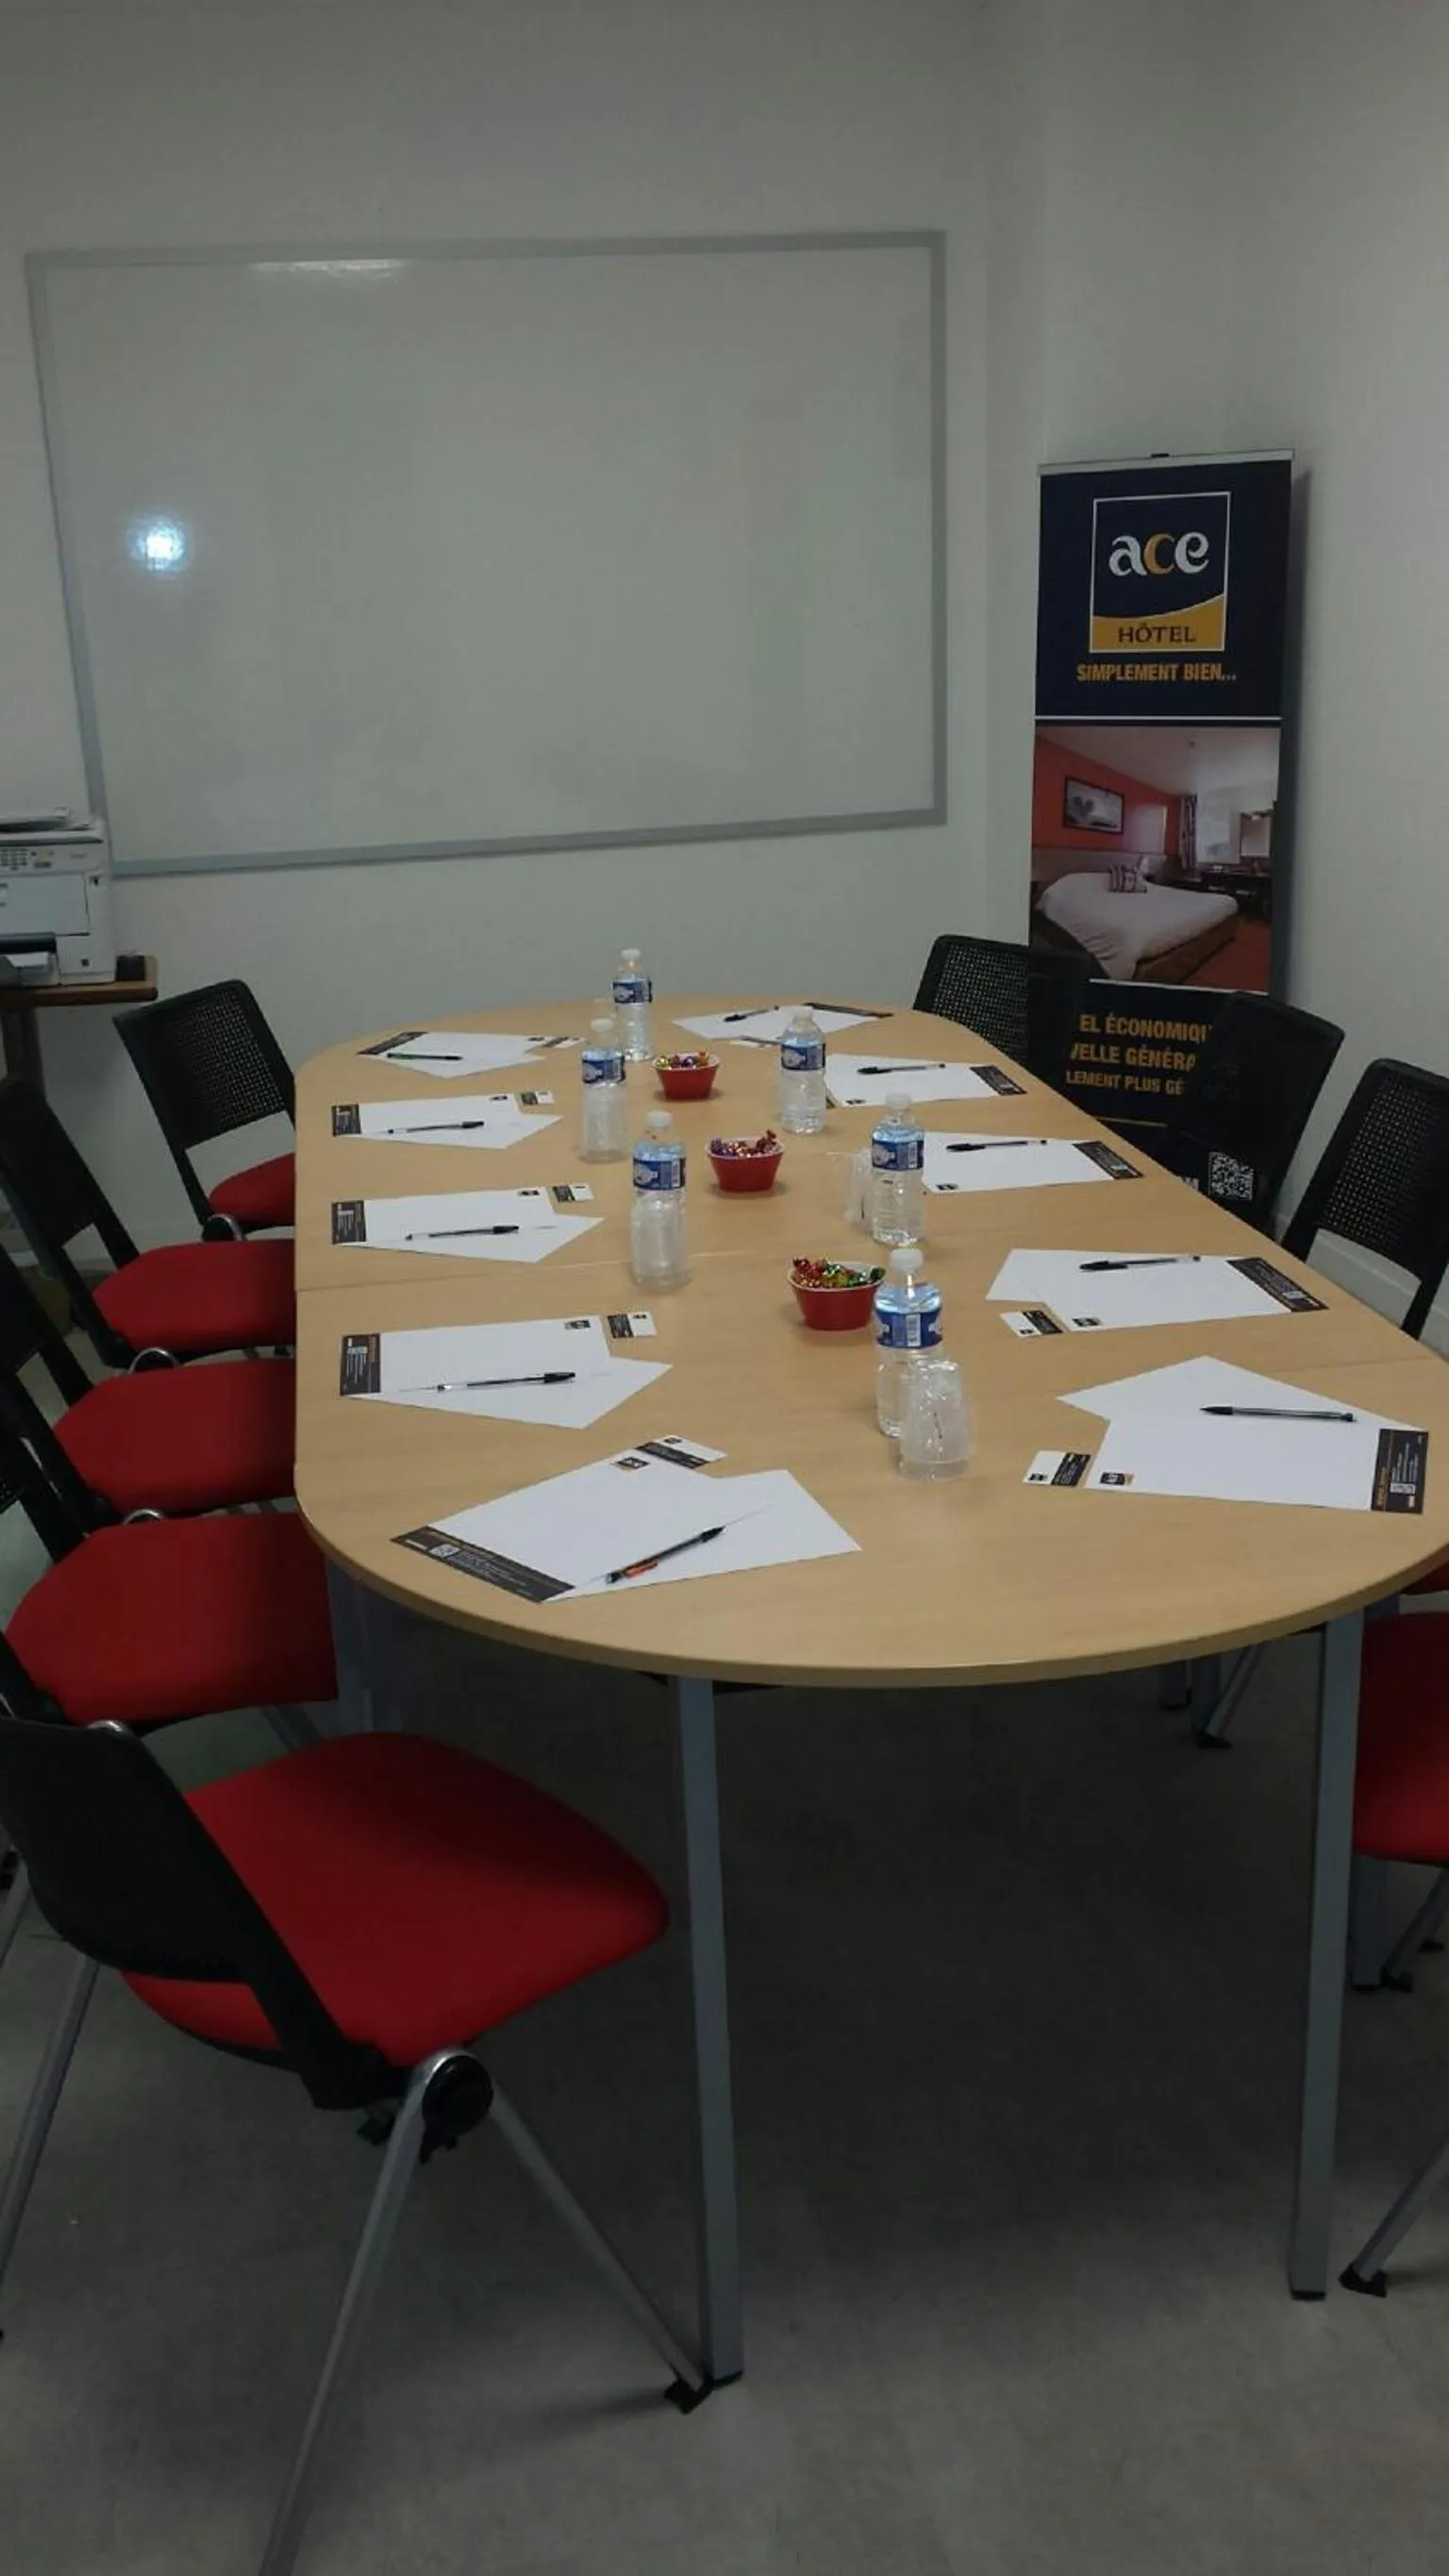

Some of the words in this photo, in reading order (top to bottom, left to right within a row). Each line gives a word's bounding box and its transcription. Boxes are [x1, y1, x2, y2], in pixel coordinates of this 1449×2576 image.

[1108, 531, 1209, 577] ace
[1118, 623, 1195, 643] HÔTEL
[1076, 663, 1179, 681] SIMPLEMENT
[1184, 662, 1237, 681] BIEN...
[1066, 1069, 1122, 1089] LEMENT
[1124, 1075, 1160, 1093] PLUS
